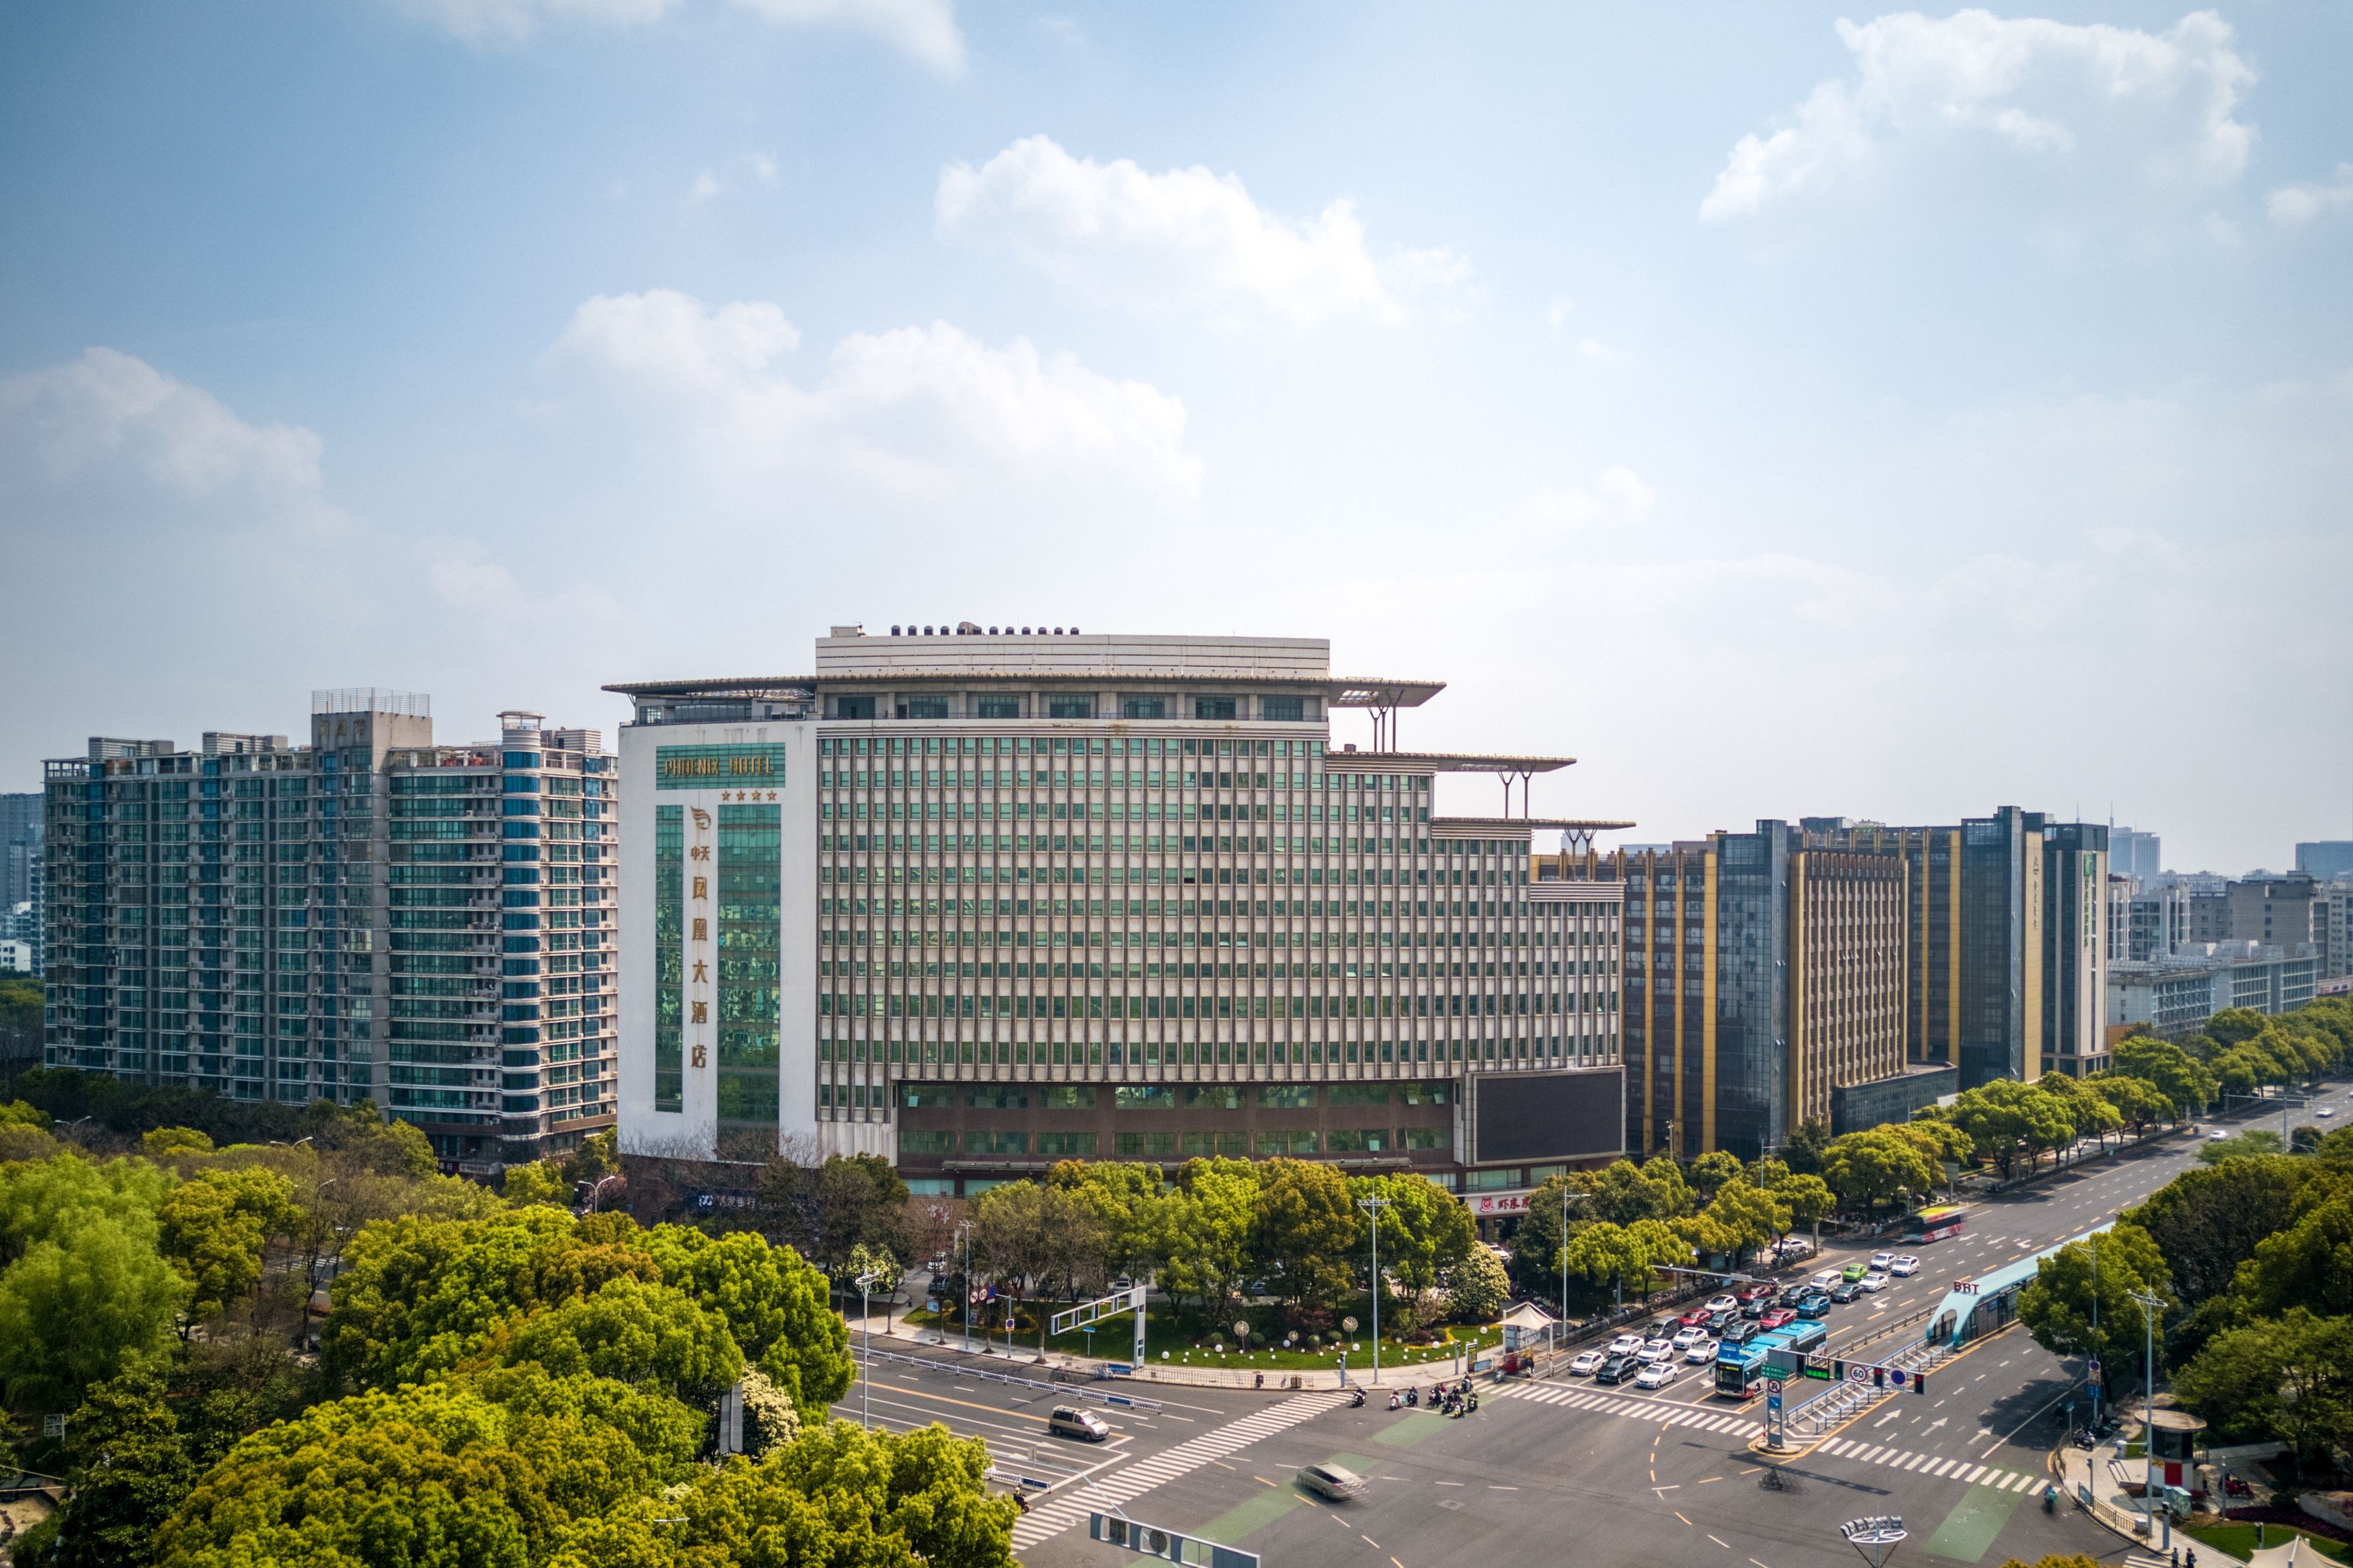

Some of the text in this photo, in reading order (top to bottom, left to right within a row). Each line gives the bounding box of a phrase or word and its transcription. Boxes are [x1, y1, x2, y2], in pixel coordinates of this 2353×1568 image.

[665, 757, 774, 776] PHOENIX HOTEL
[1954, 1280, 1979, 1295] BRT
[1853, 1369, 1863, 1378] 60
